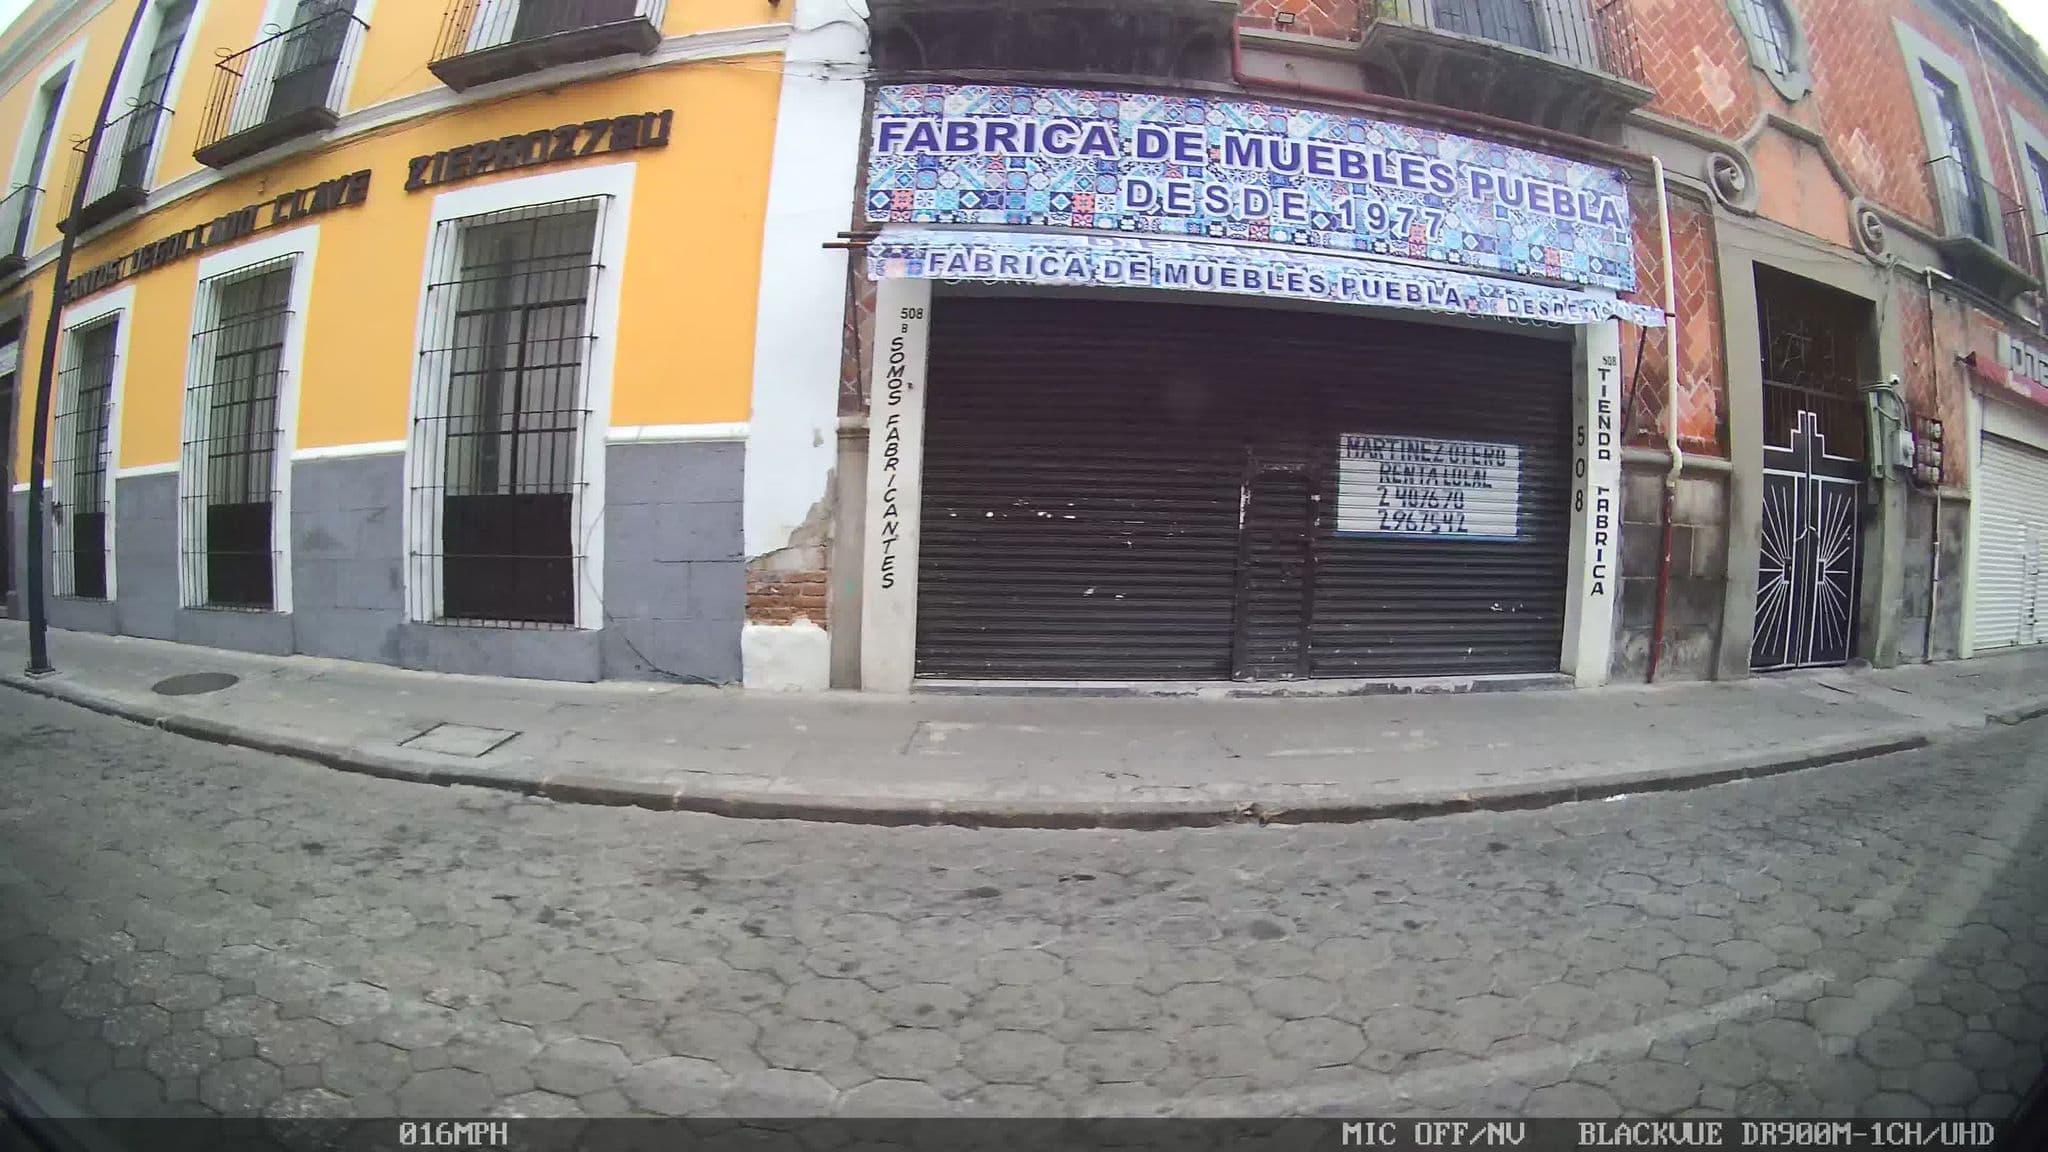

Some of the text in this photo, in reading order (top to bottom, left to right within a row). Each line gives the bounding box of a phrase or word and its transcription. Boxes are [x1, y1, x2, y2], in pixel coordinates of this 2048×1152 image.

[273, 169, 372, 219] CLAVE
[878, 121, 1624, 230] FABRICA DE MUEBLES PUEBLA
[1128, 179, 1443, 238] DESDE 1977
[901, 307, 923, 319] 508
[929, 251, 1088, 278] FABRICA
[1104, 259, 1149, 282] DE
[1165, 264, 1326, 293] MUEBLES
[1342, 277, 1462, 308] PUEBLA
[1507, 297, 1580, 318] DESDE
[886, 337, 905, 405] SOMOS
[881, 414, 901, 589] FABRICANTES
[1379, 460, 1438, 485] RENTA
